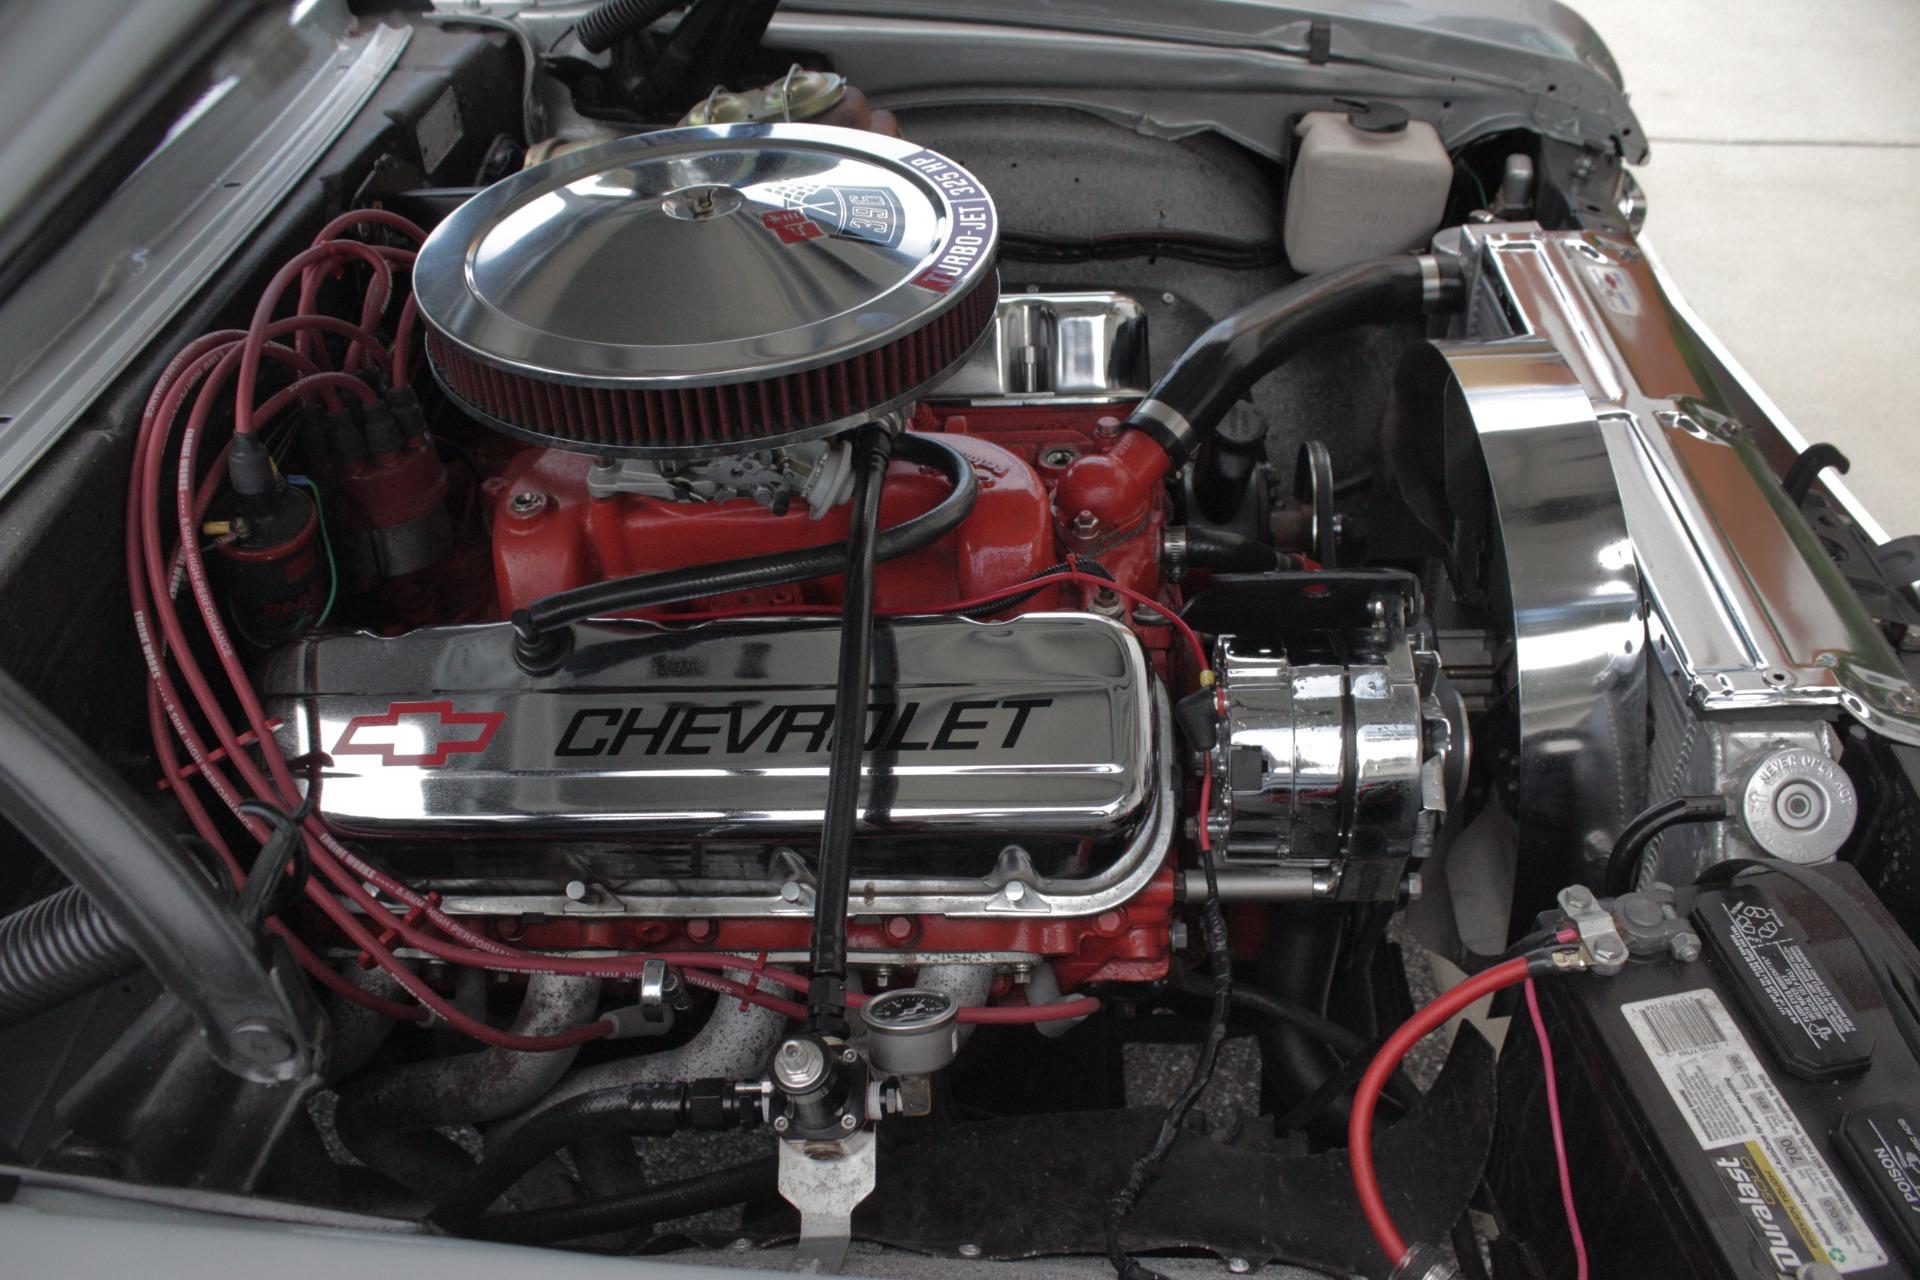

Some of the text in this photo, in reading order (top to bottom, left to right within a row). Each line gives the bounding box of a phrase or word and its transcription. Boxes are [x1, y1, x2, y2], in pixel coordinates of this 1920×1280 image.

[849, 195, 888, 234] 396
[911, 158, 986, 284] TURBO-JET 325 HP
[178, 458, 190, 490] WORKS
[181, 516, 194, 549] 8.5MM
[188, 553, 202, 581] HIGH
[193, 580, 233, 658] PERFORMANCE
[134, 610, 254, 832] ENGINE WORKS 8.5MM HIGH PERFORMANCE
[1759, 755, 1798, 785] NEVER
[319, 832, 347, 859] ENGINE
[344, 853, 376, 880] WORKS
[426, 907, 451, 929] HIGH
[1777, 1138, 1804, 1163] 700
[1873, 1146, 1919, 1203] POISON
[1737, 1155, 1777, 1206] GOLD
[1715, 1157, 1803, 1272] Duralast
